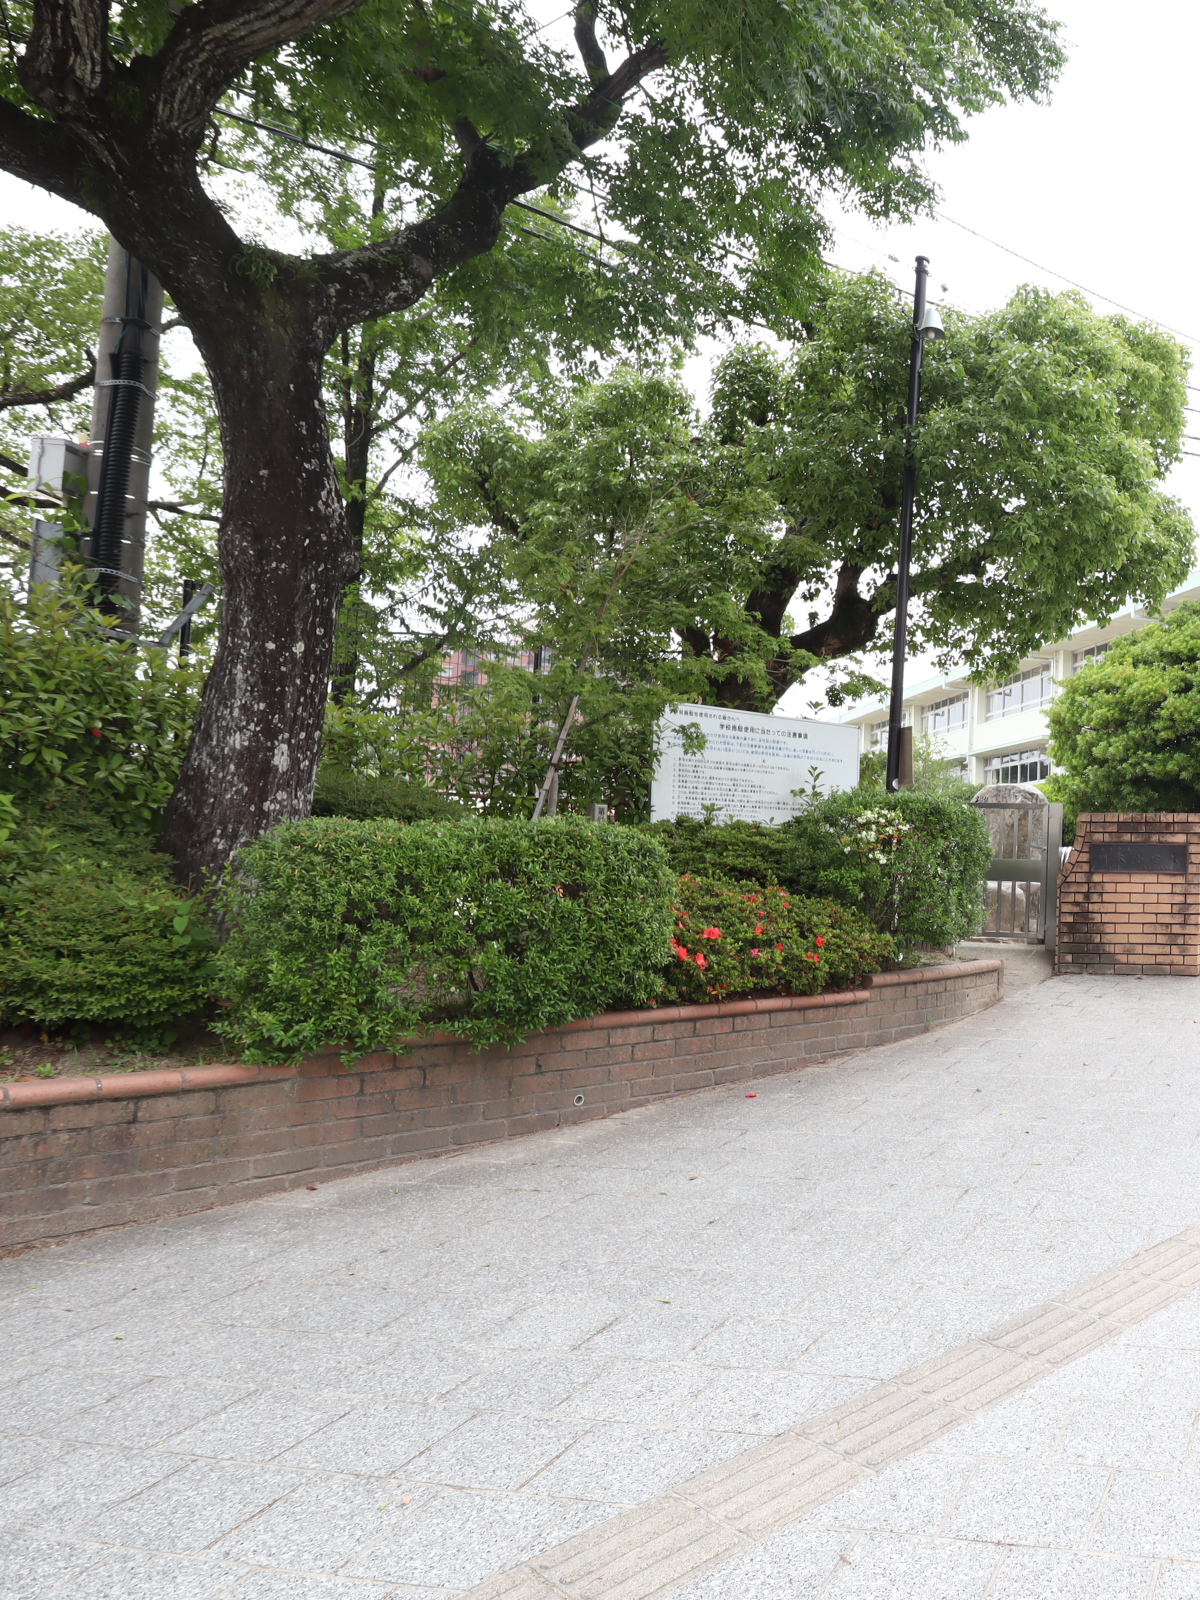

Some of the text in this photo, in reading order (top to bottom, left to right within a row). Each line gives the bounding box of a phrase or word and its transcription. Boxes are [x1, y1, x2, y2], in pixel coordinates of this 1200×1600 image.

[719, 722, 808, 740] 学校施設使用に当たっての注意事項
